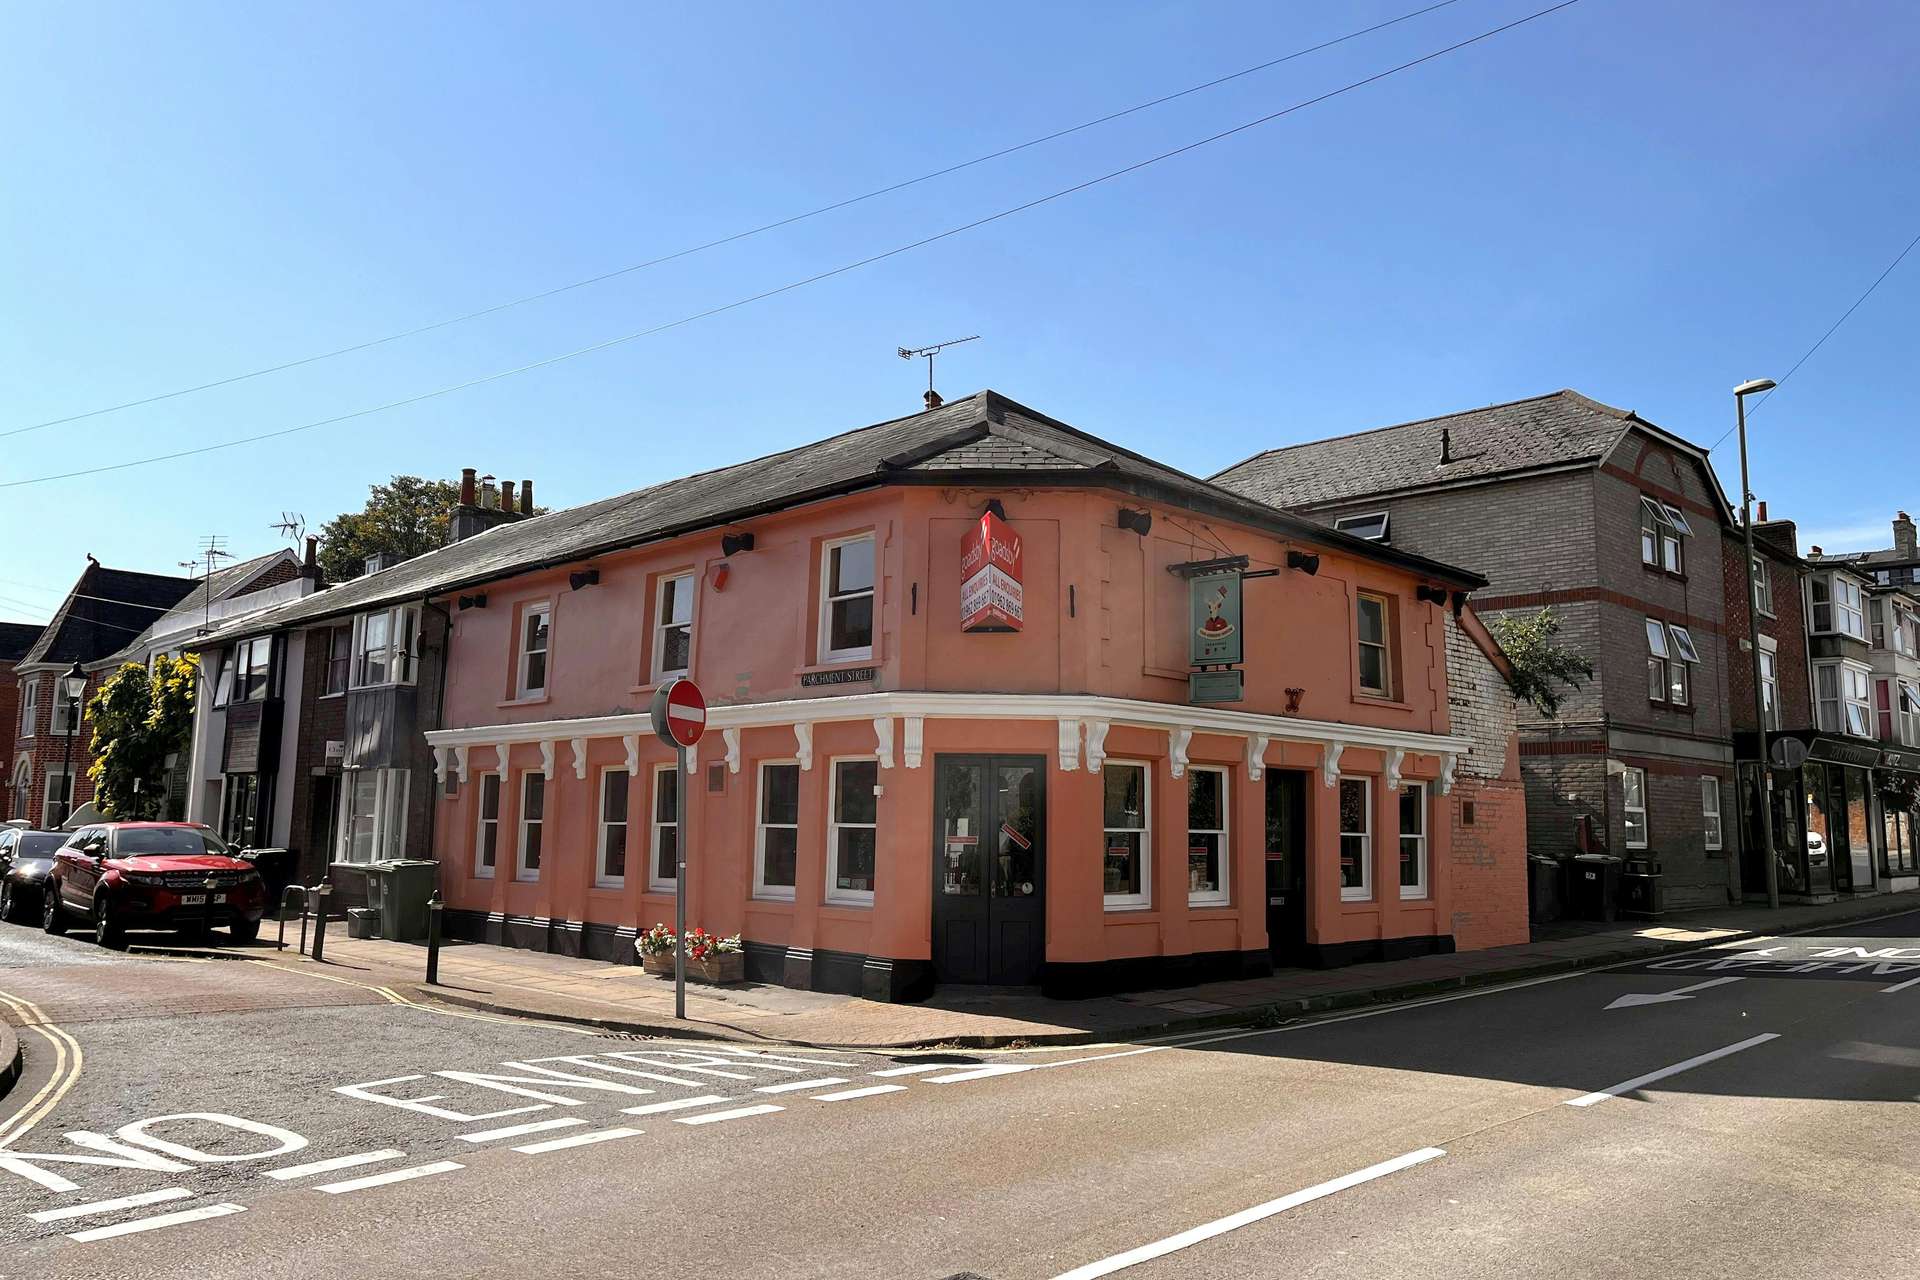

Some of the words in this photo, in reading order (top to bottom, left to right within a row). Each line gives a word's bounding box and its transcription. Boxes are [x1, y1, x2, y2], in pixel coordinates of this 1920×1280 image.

[803, 671, 844, 686] PARCHMENT
[847, 669, 872, 681] STREET
[332, 1047, 859, 1122] ENTRY
[0, 1111, 310, 1192] NO
